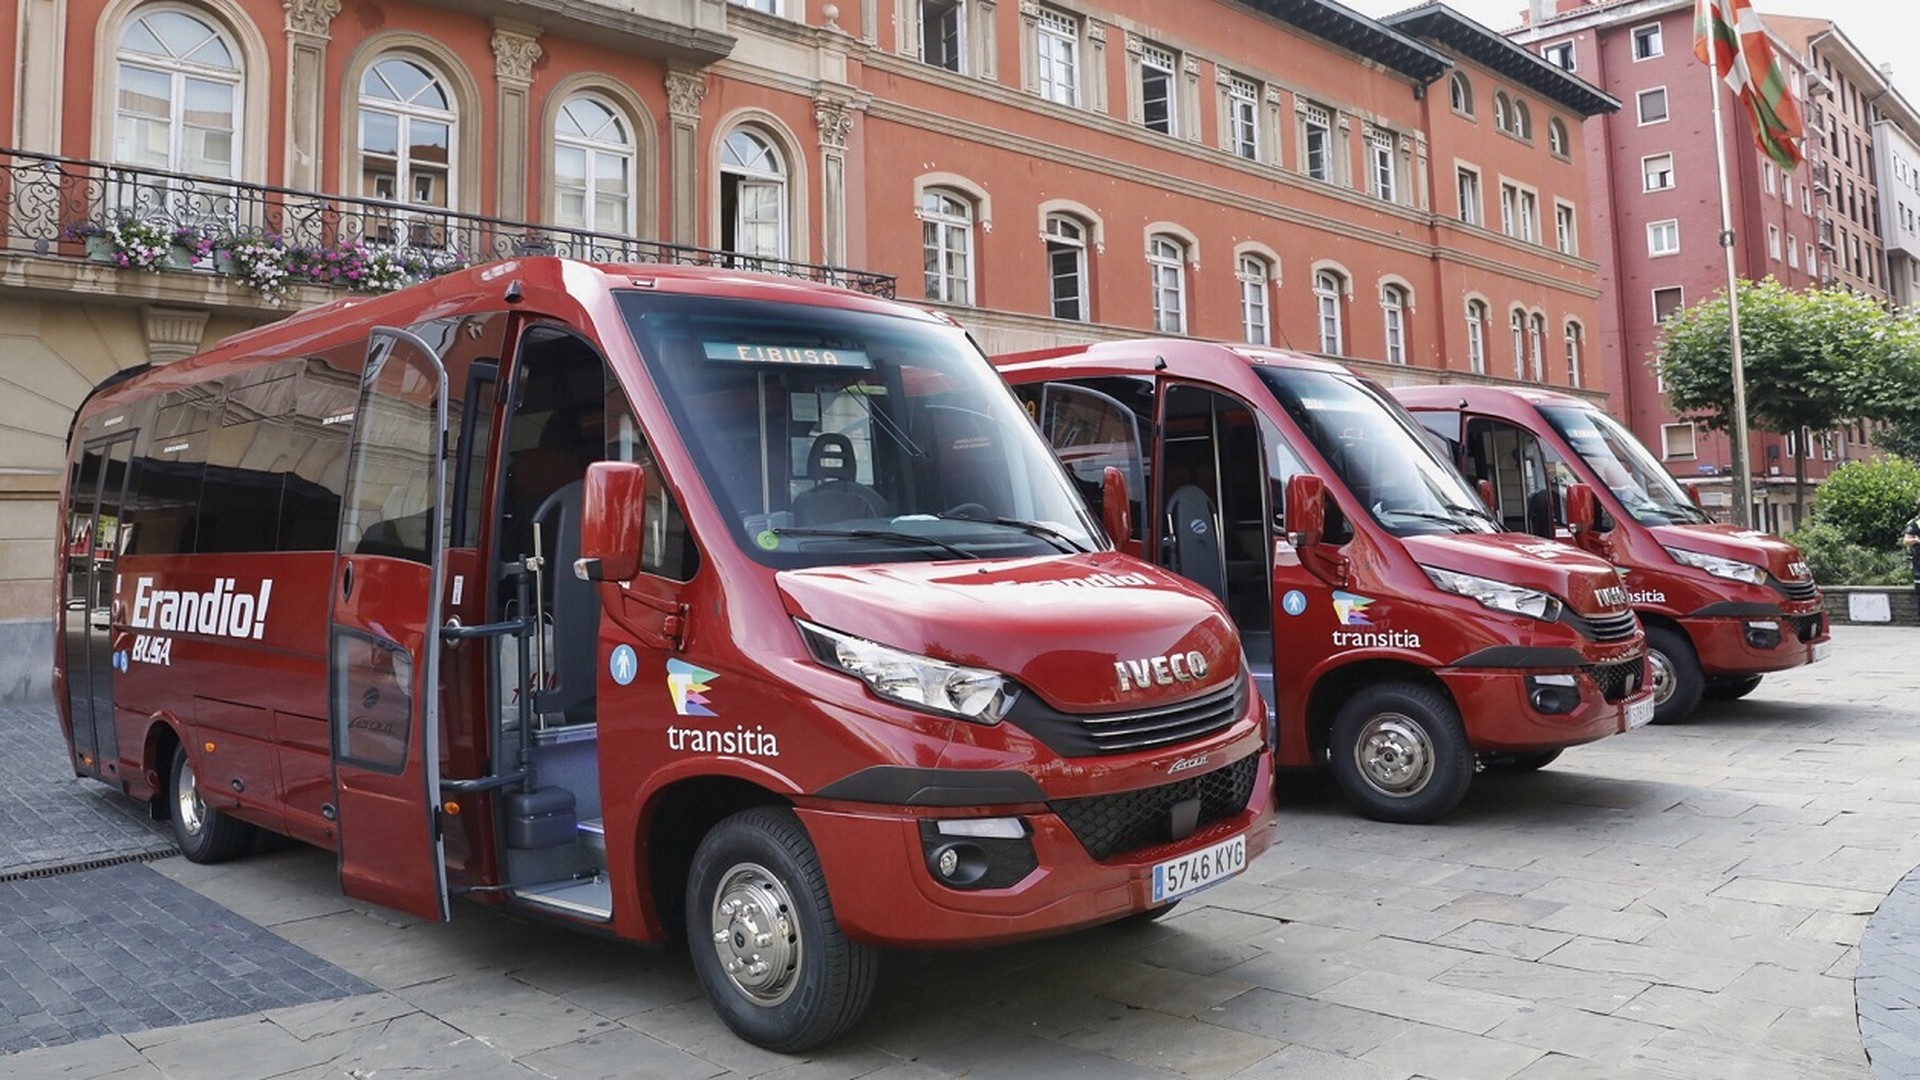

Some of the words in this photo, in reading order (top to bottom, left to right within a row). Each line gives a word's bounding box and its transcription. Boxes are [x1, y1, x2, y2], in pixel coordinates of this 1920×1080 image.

[131, 577, 273, 640] Erandio!
[131, 634, 173, 666] BUSA
[1332, 629, 1421, 648] transitia
[1113, 650, 1208, 692] IVECO
[666, 724, 780, 757] transitia
[1167, 853, 1211, 893] 5746
[1215, 841, 1243, 876] KYG
